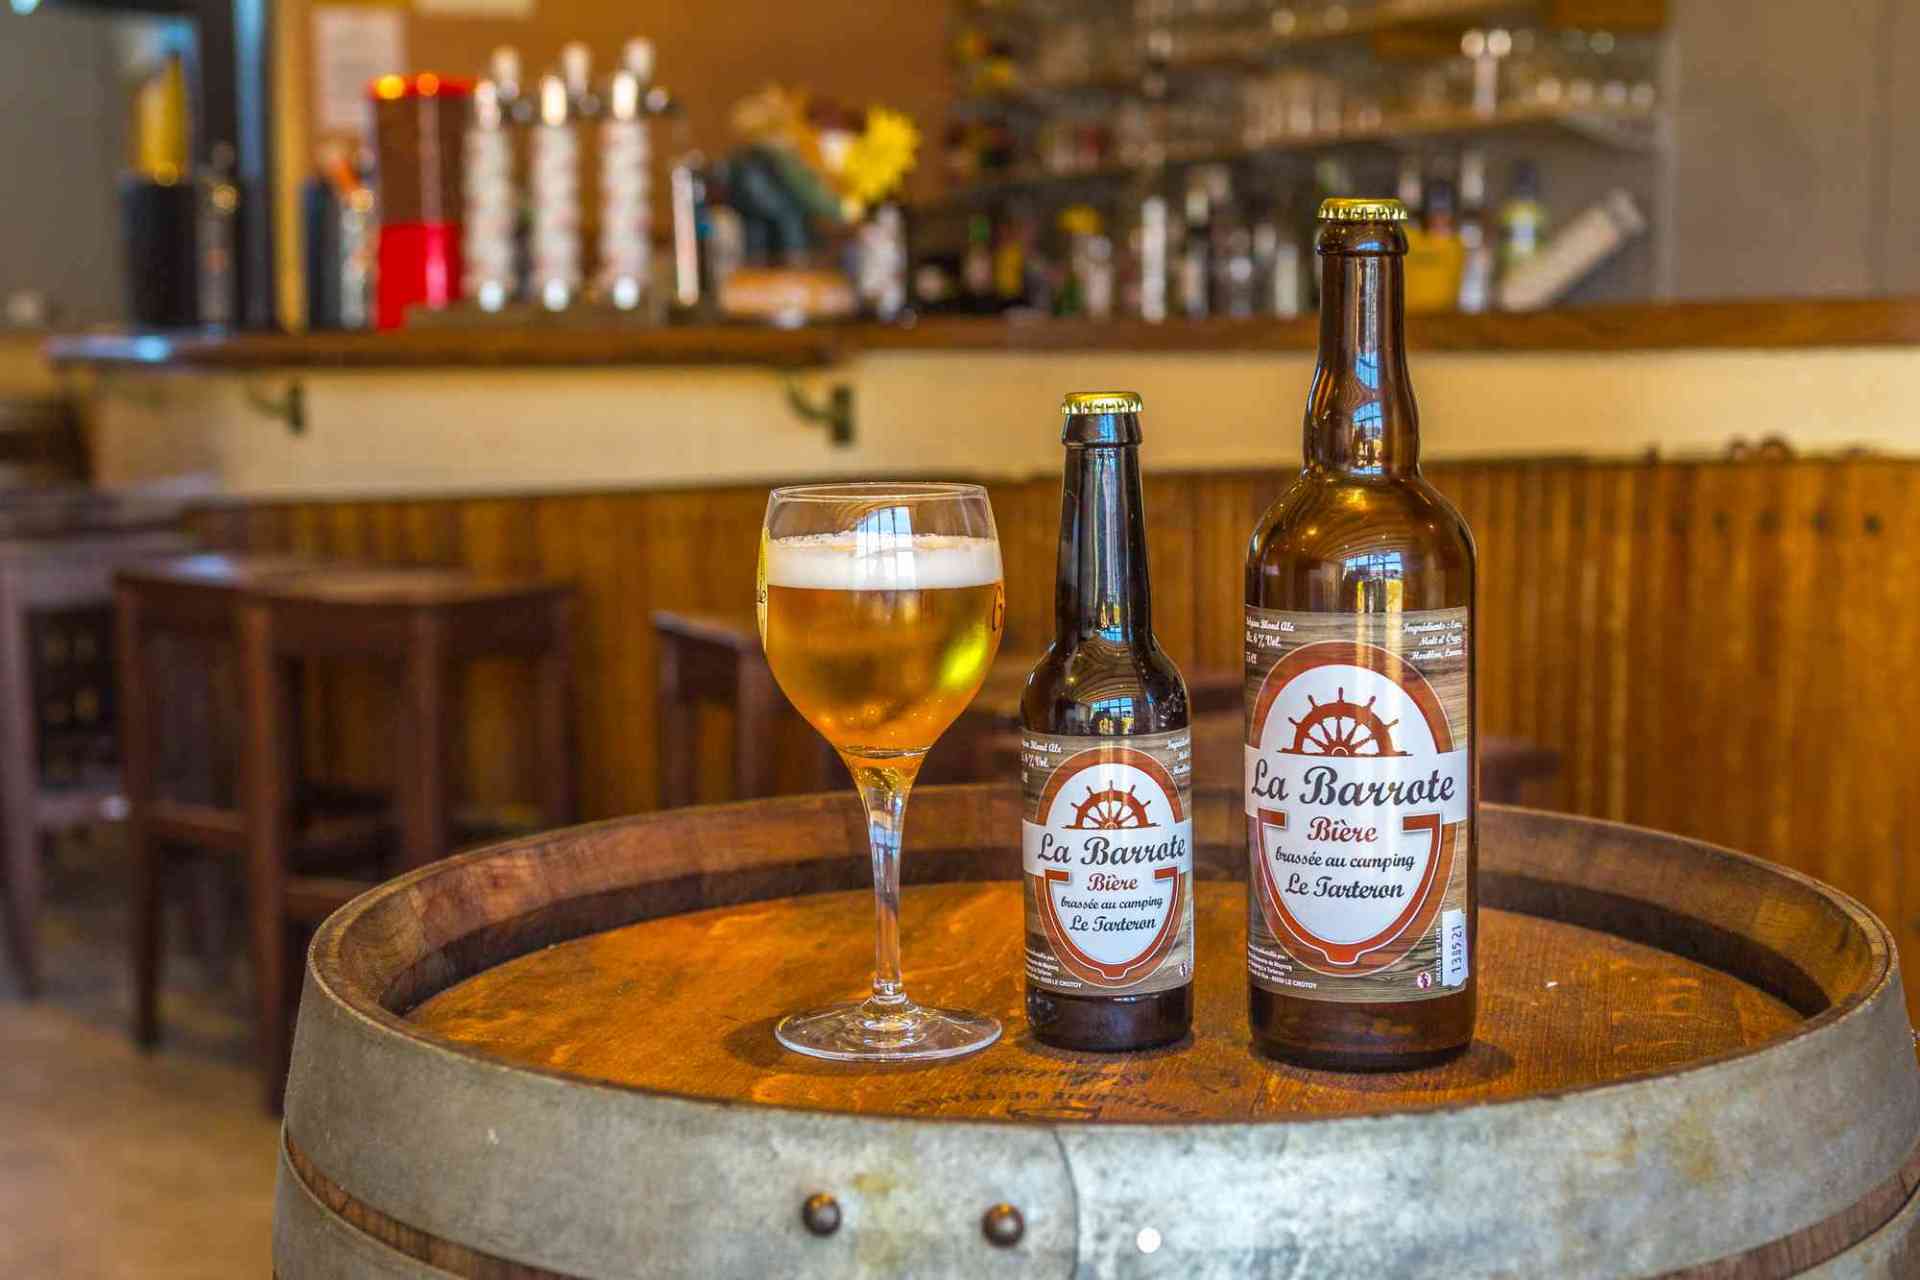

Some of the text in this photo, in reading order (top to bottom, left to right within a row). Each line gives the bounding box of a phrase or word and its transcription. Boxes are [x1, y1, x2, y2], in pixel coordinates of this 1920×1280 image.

[1251, 758, 1456, 807] La Barrote
[1307, 816, 1378, 843] Bière
[1037, 832, 1186, 866] La Barrote
[1275, 846, 1416, 873] brassée au camping
[1087, 872, 1138, 892] Bière
[1285, 872, 1406, 899] Le Tarteron
[1061, 896, 1164, 911] brassée au camping
[1069, 915, 1157, 932] Le Tarteron
